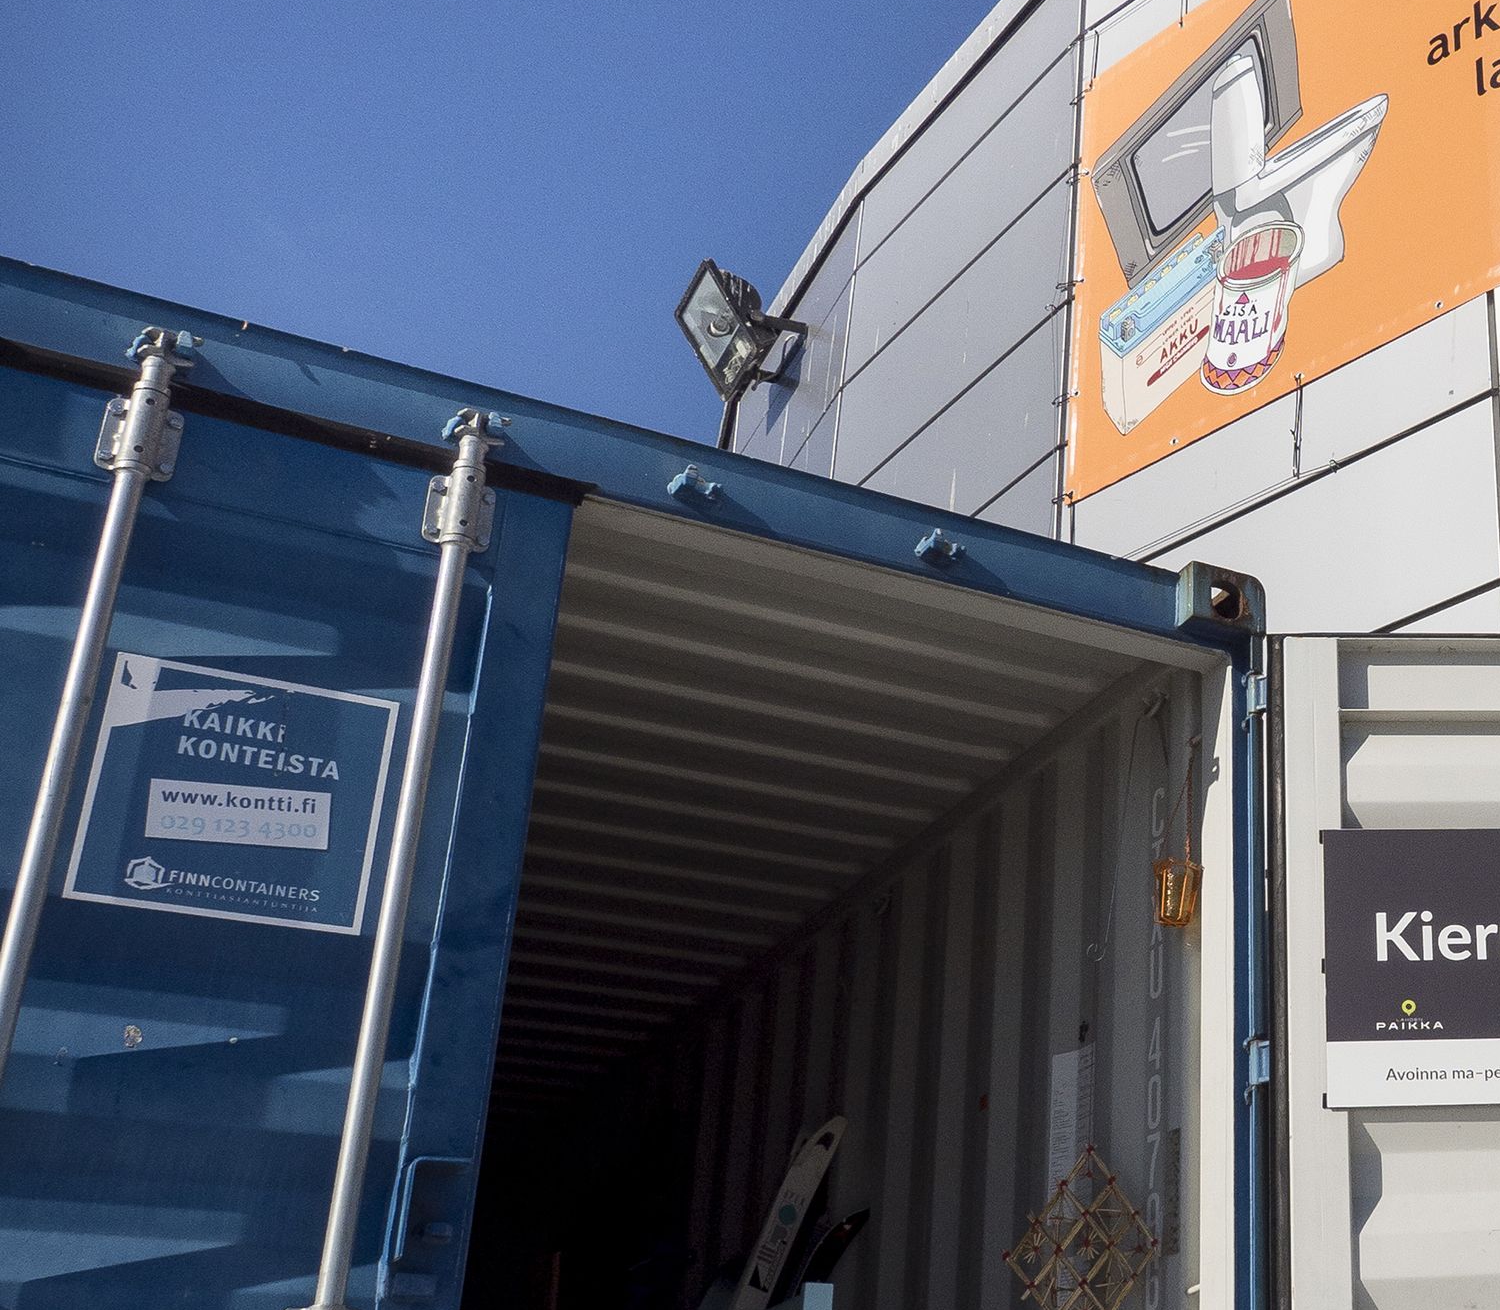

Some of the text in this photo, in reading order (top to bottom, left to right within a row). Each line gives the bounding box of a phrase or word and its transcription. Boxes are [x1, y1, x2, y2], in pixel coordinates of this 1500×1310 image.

[1159, 318, 1199, 364] AKKU
[1212, 310, 1270, 345] MAALI
[177, 735, 340, 781] KONTEISTA
[161, 788, 317, 814] www.kontti.fi
[160, 815, 318, 841] 029 123 4300
[168, 870, 320, 902] FINNCONTAINERS
[1376, 1021, 1444, 1031] PAIKKA
[1386, 1067, 1447, 1081] Avoinna
